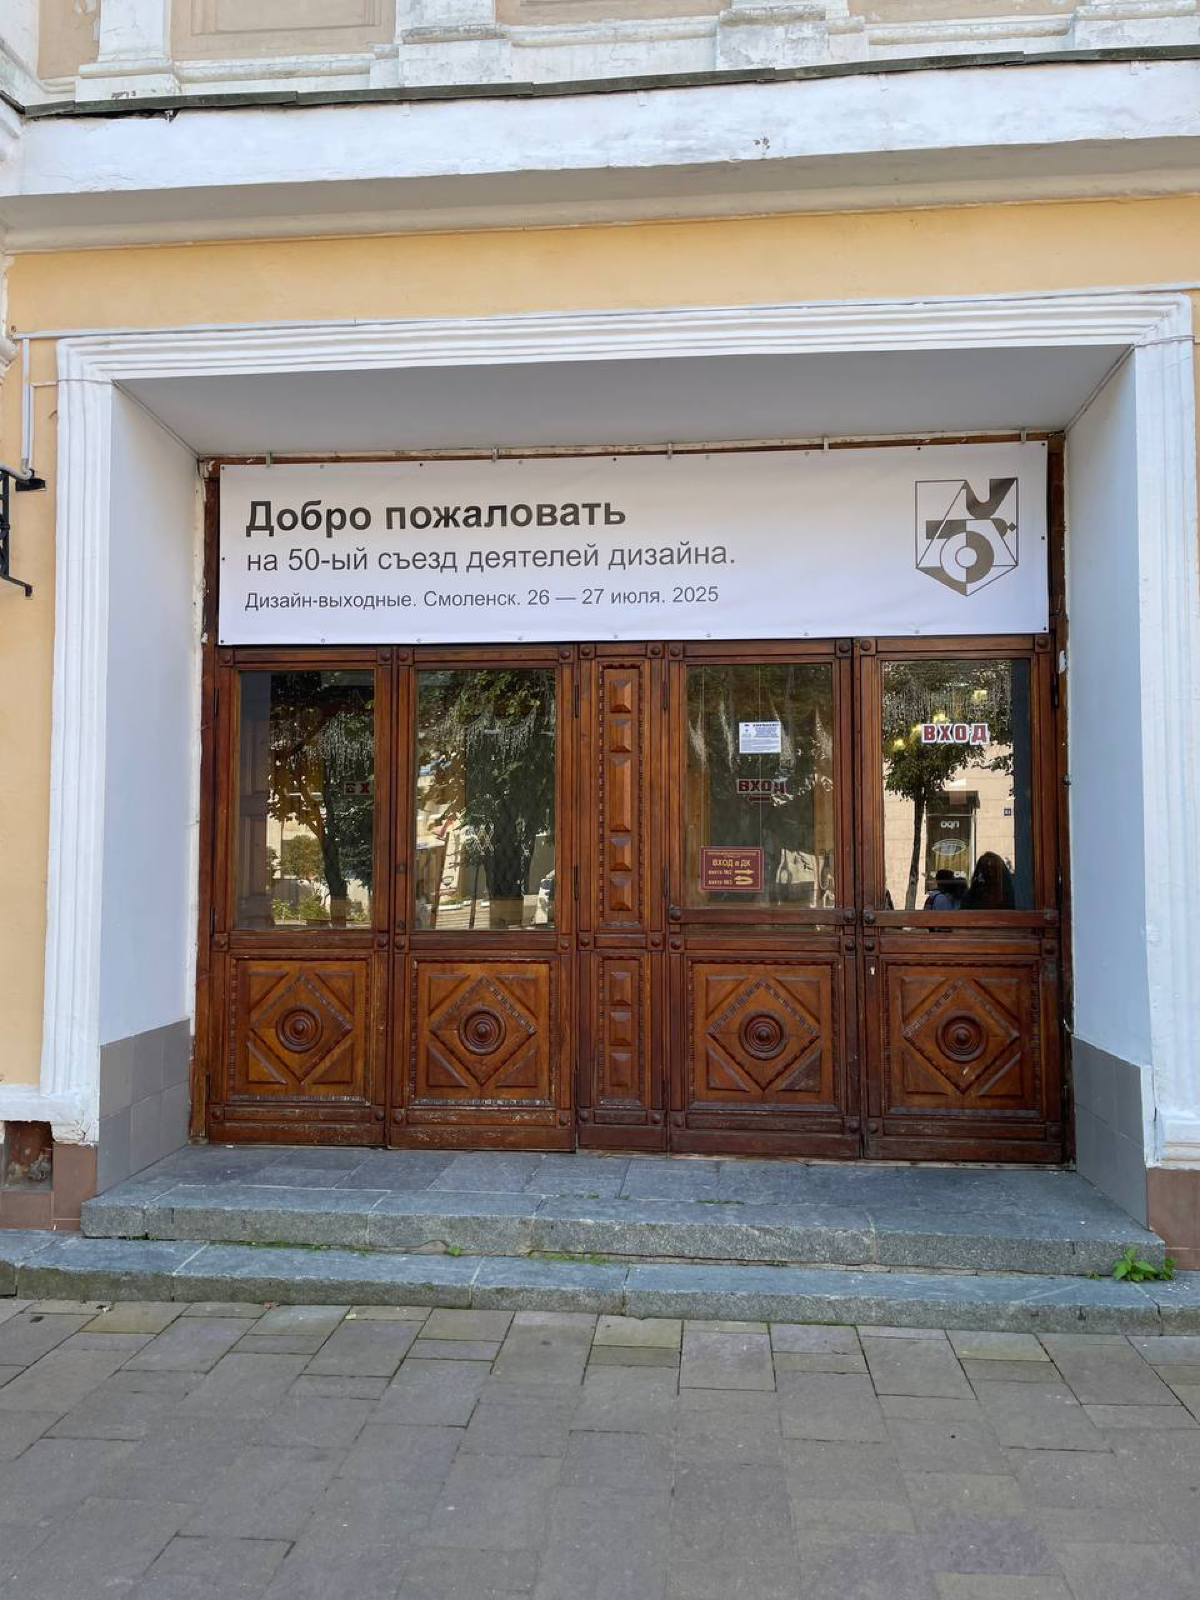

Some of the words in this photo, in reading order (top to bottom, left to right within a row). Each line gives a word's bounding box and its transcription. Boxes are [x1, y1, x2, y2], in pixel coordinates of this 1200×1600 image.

[246, 500, 371, 539] Добро
[386, 498, 626, 530] пожаловать
[247, 553, 278, 571] на
[288, 547, 367, 571] 50-ый
[378, 551, 458, 573] съезд
[466, 543, 599, 573] деятелей
[608, 541, 735, 570] дизайна.
[245, 592, 416, 611] Дизайн-выходные.
[424, 590, 521, 606] Смоленск.
[527, 589, 550, 605] 26
[582, 588, 605, 604] 27
[611, 591, 665, 605] июля.
[672, 586, 719, 603] 2025
[922, 724, 989, 745] ВХОД
